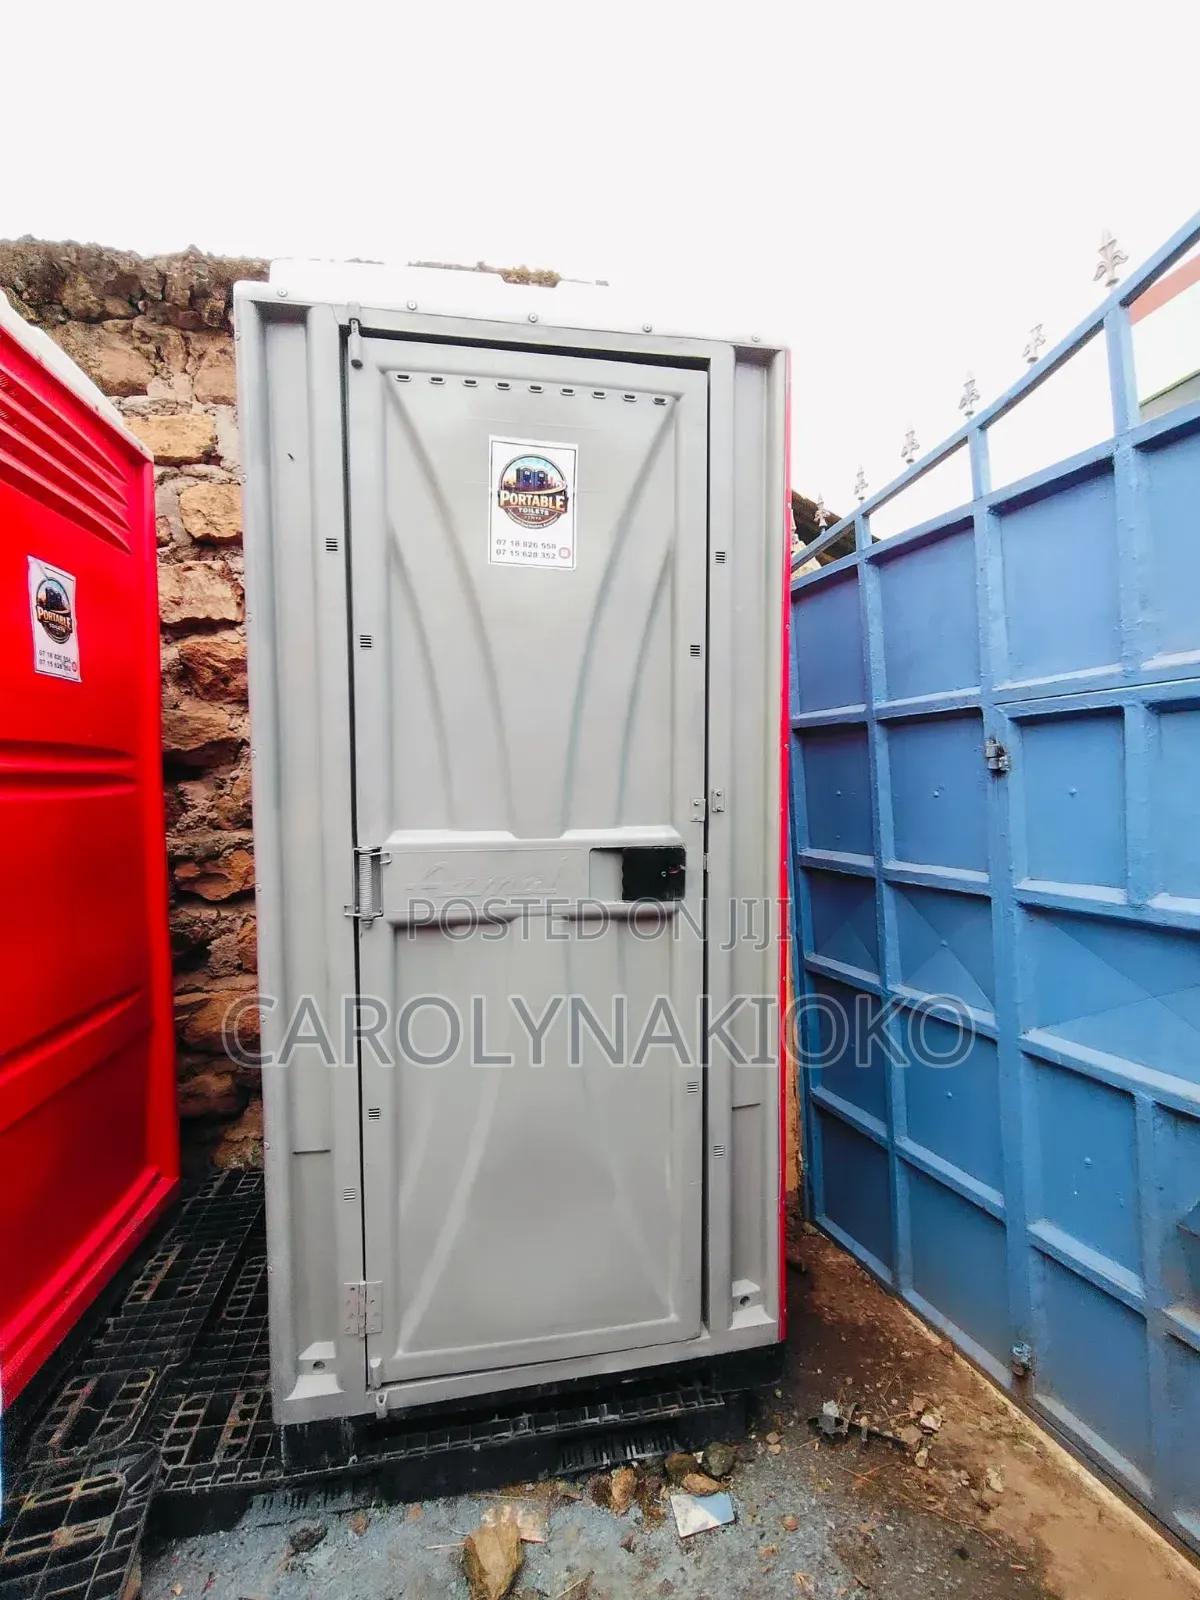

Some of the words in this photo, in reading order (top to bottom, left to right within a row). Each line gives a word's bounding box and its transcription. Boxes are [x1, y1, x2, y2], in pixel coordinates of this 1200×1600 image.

[500, 490, 566, 511] PORTABLE
[519, 507, 549, 516] TOILETS
[37, 605, 72, 630] PORTABLE
